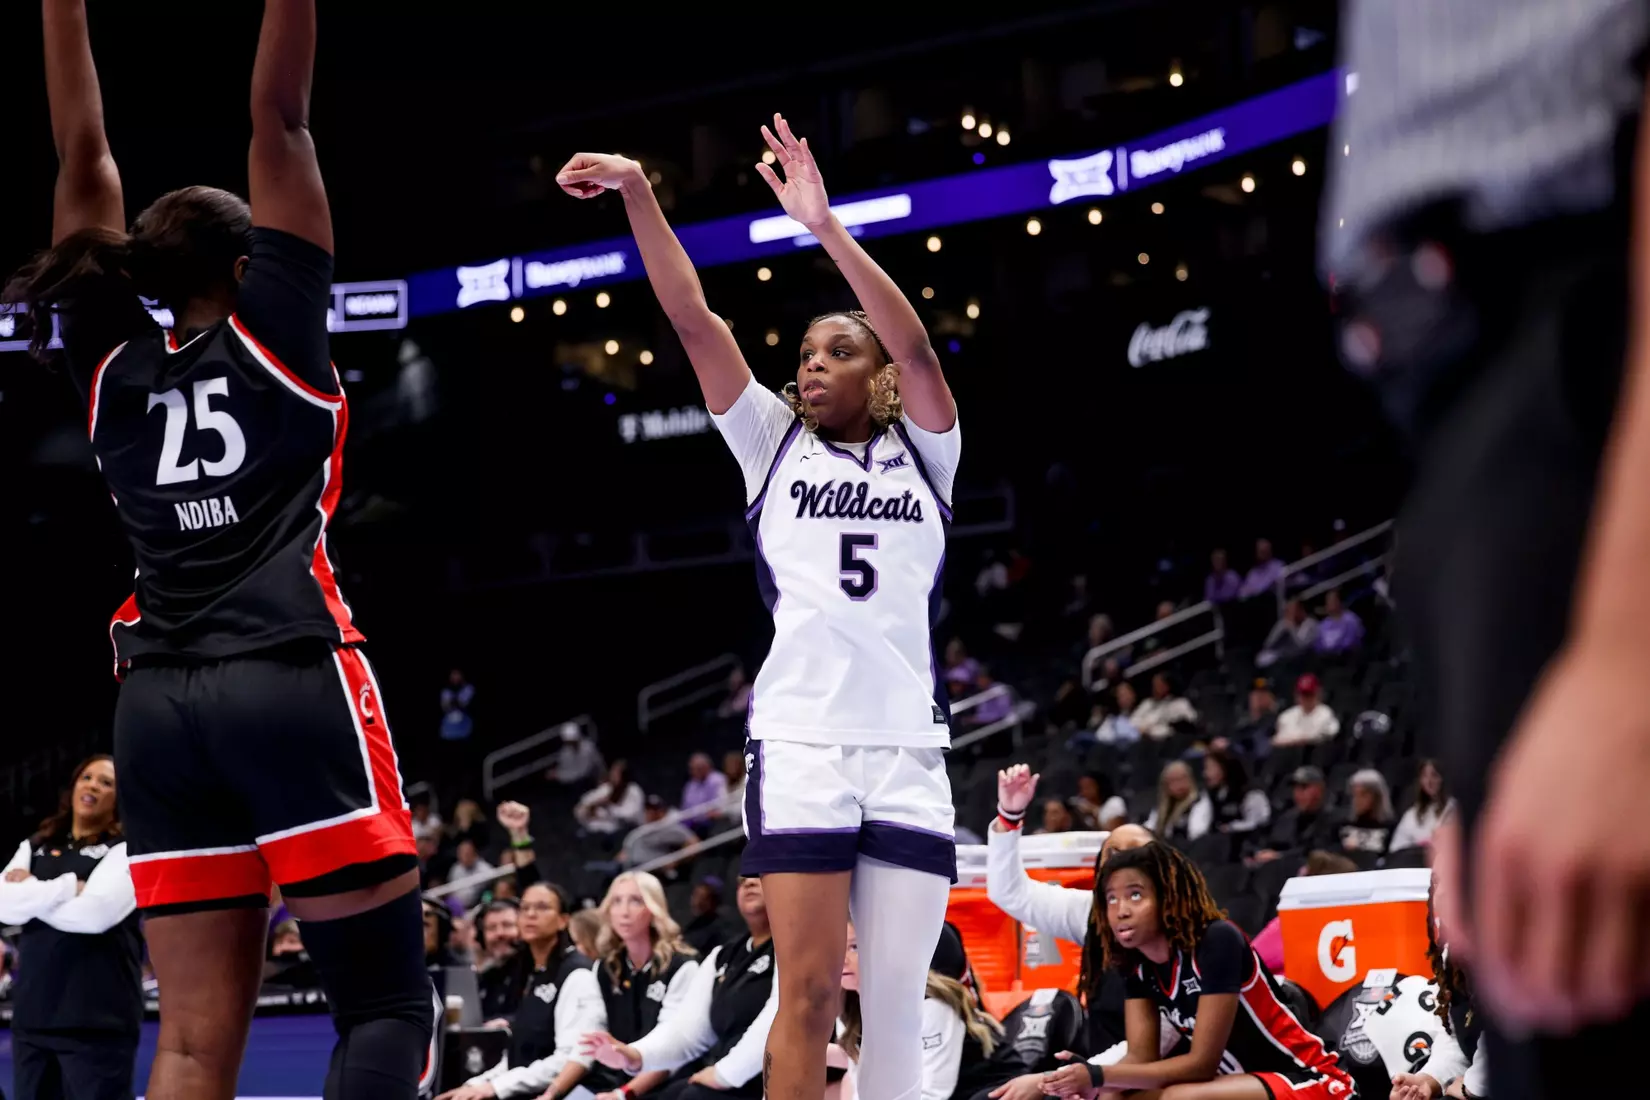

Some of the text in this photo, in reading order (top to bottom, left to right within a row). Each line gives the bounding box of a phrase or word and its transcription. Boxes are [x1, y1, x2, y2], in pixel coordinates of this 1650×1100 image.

[147, 376, 246, 486] 25
[174, 495, 240, 531] NDIBA
[790, 479, 924, 523] Wildcats
[839, 532, 879, 602] 5
[1317, 919, 1357, 983] G
